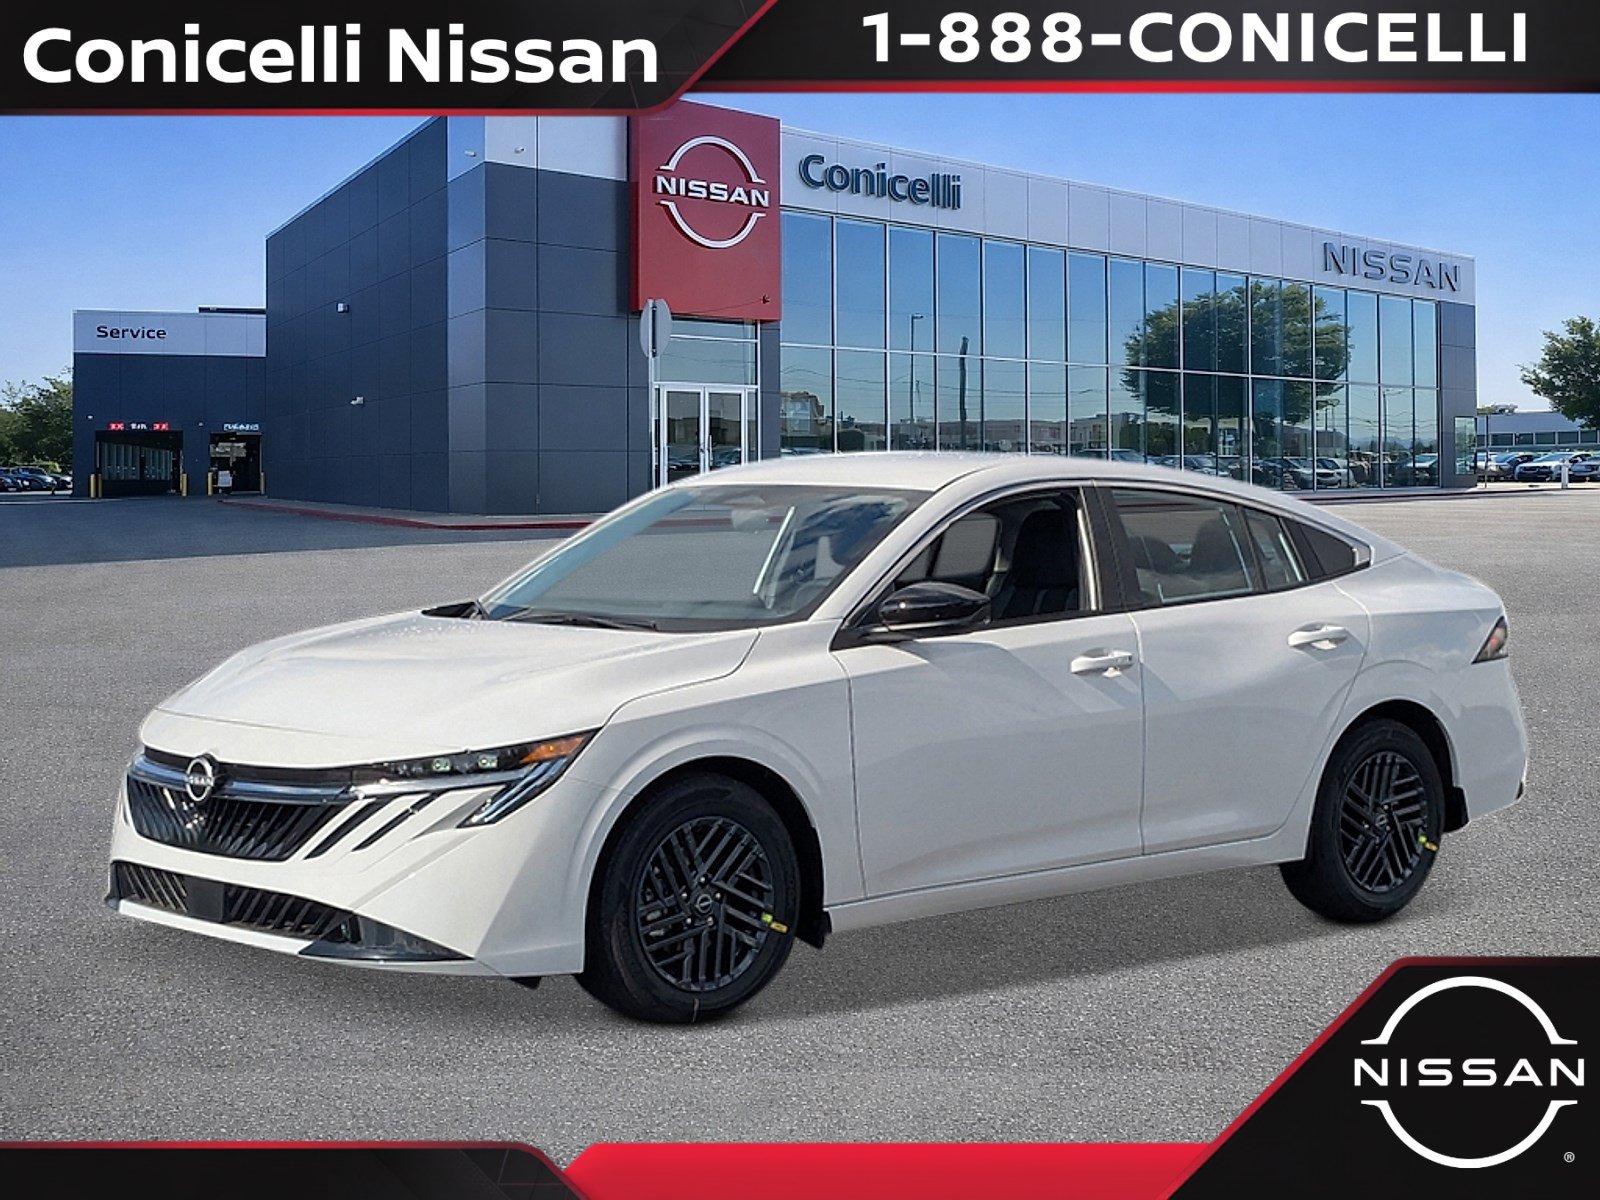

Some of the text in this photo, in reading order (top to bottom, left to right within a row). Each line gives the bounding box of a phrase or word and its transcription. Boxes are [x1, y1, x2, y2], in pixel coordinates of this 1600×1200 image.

[654, 175, 769, 208] NISSAN
[799, 154, 961, 209] Conicelli
[1323, 242, 1461, 292] NISSAN
[96, 325, 167, 339] Service
